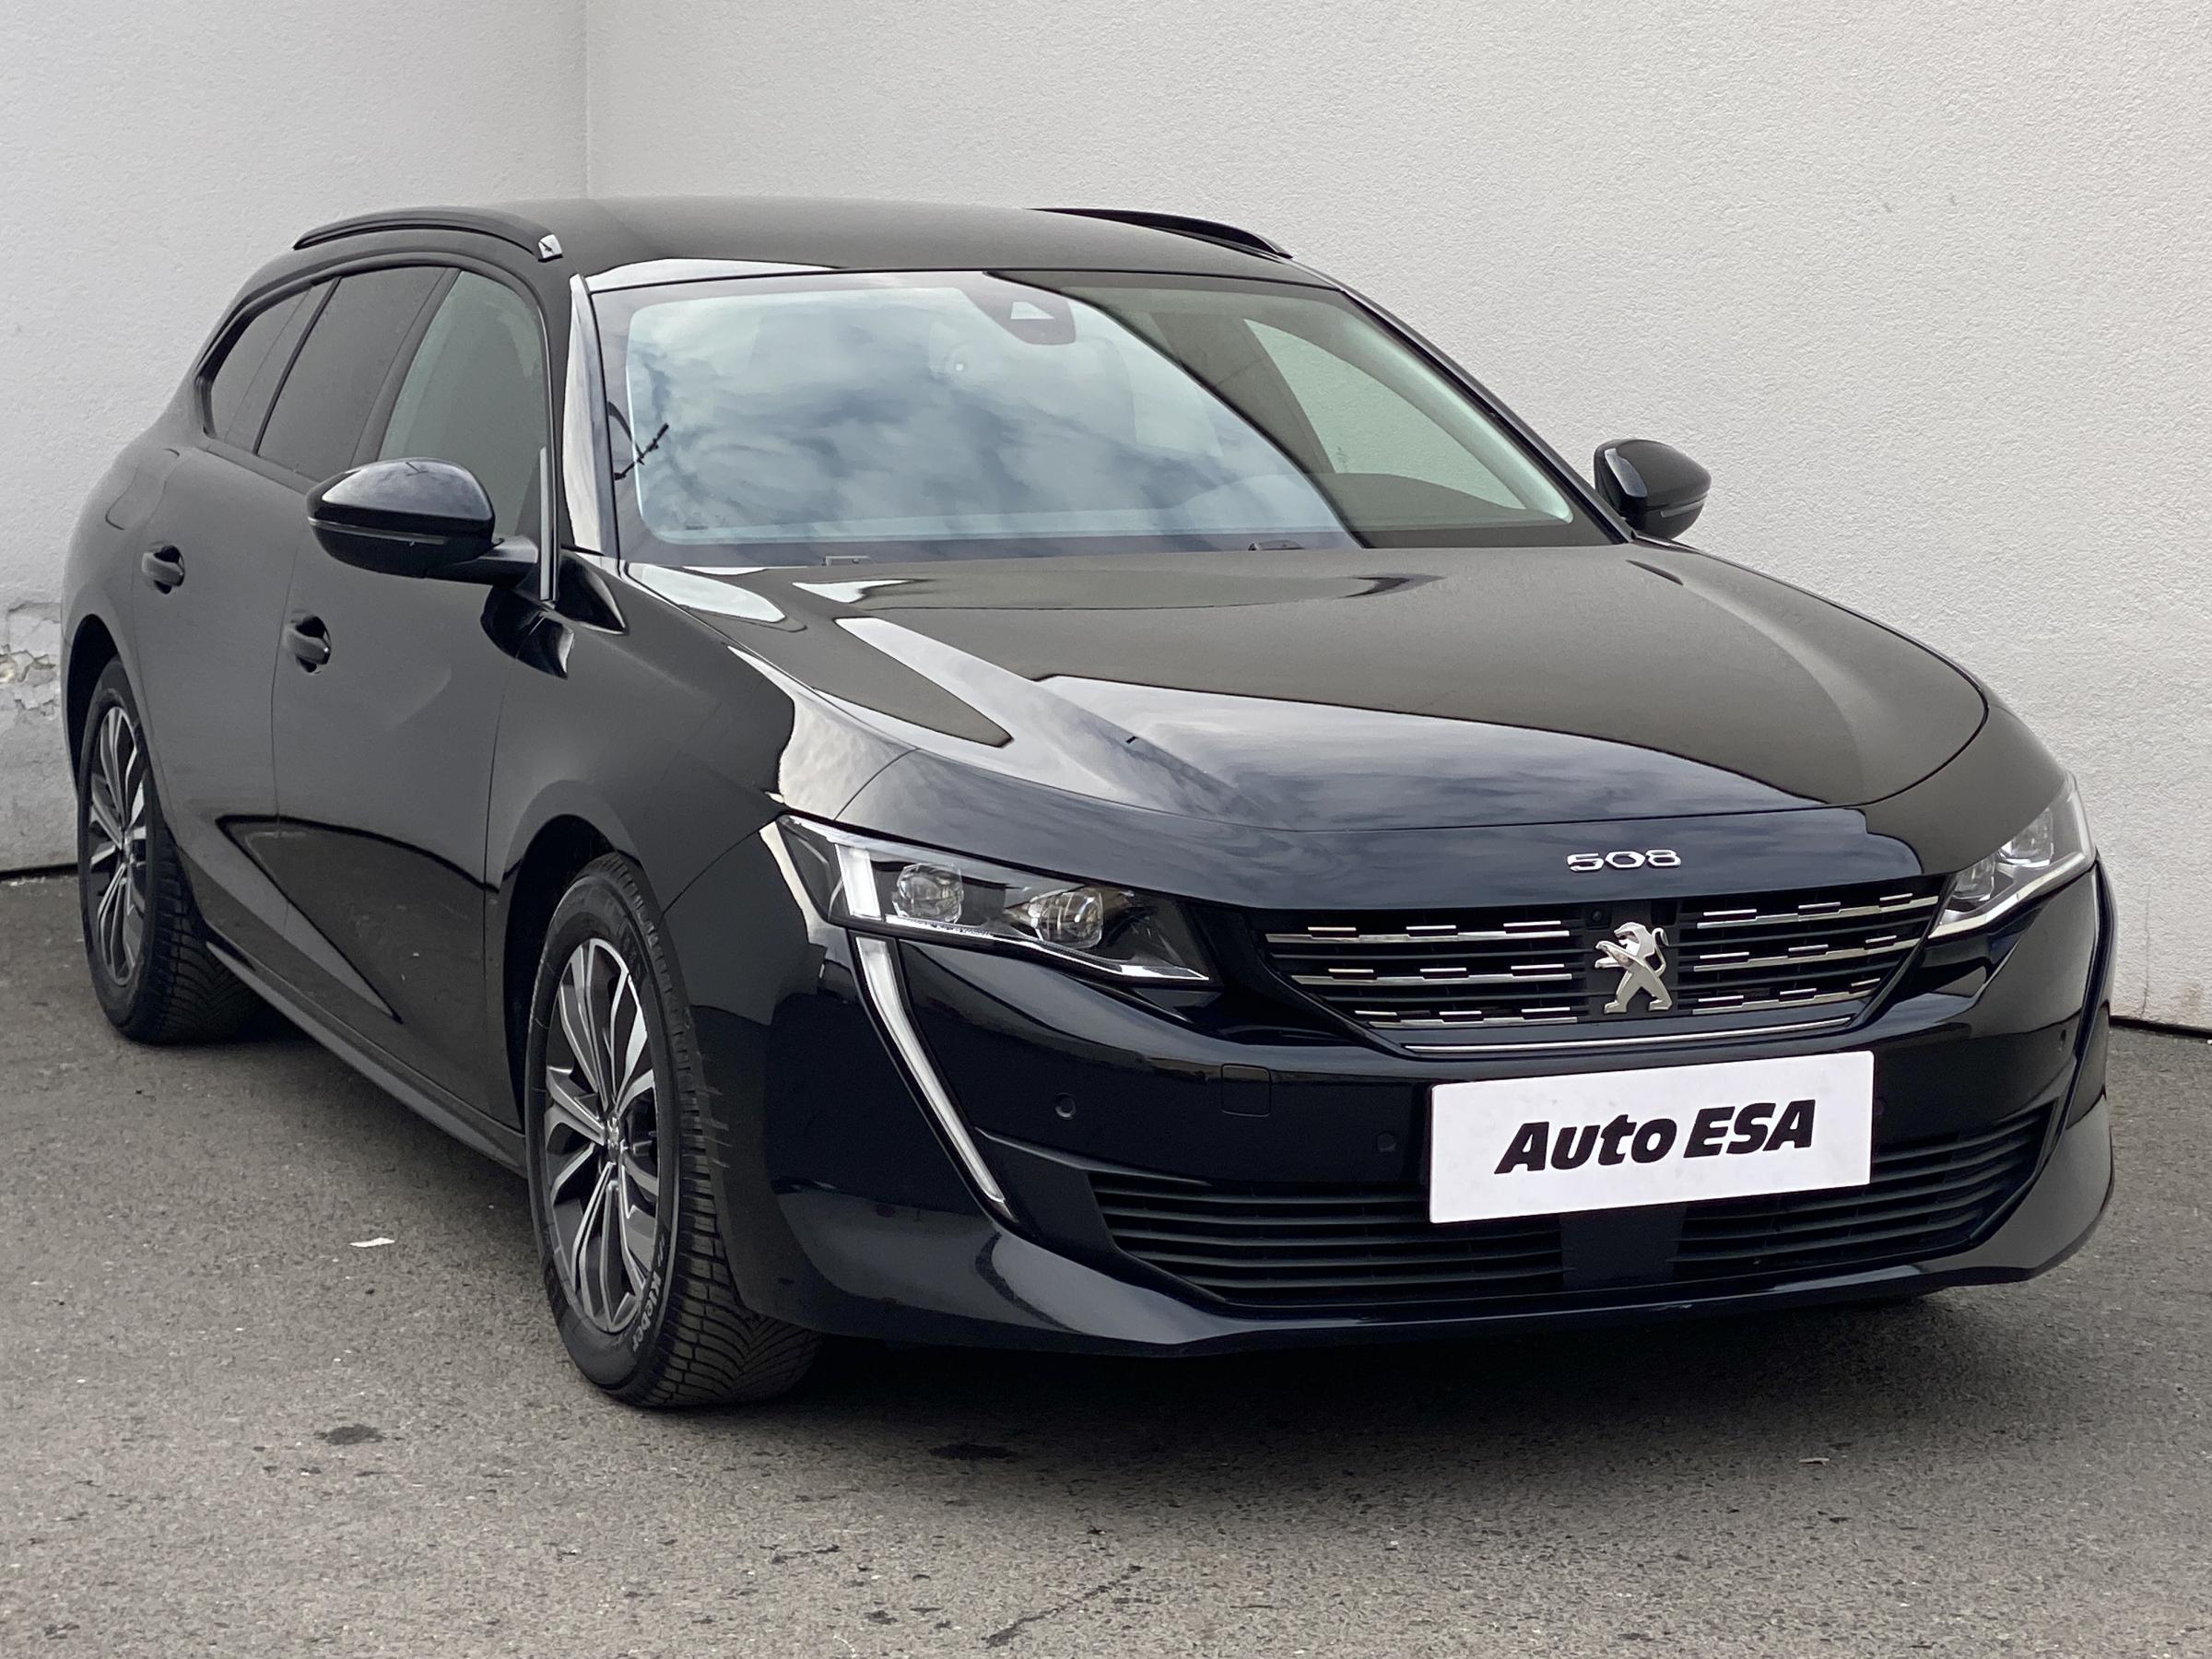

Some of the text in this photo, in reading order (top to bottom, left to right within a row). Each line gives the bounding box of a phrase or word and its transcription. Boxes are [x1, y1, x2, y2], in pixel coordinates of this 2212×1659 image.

[1567, 849, 1681, 871] 508
[1494, 1100, 1816, 1174] Auto ESA
